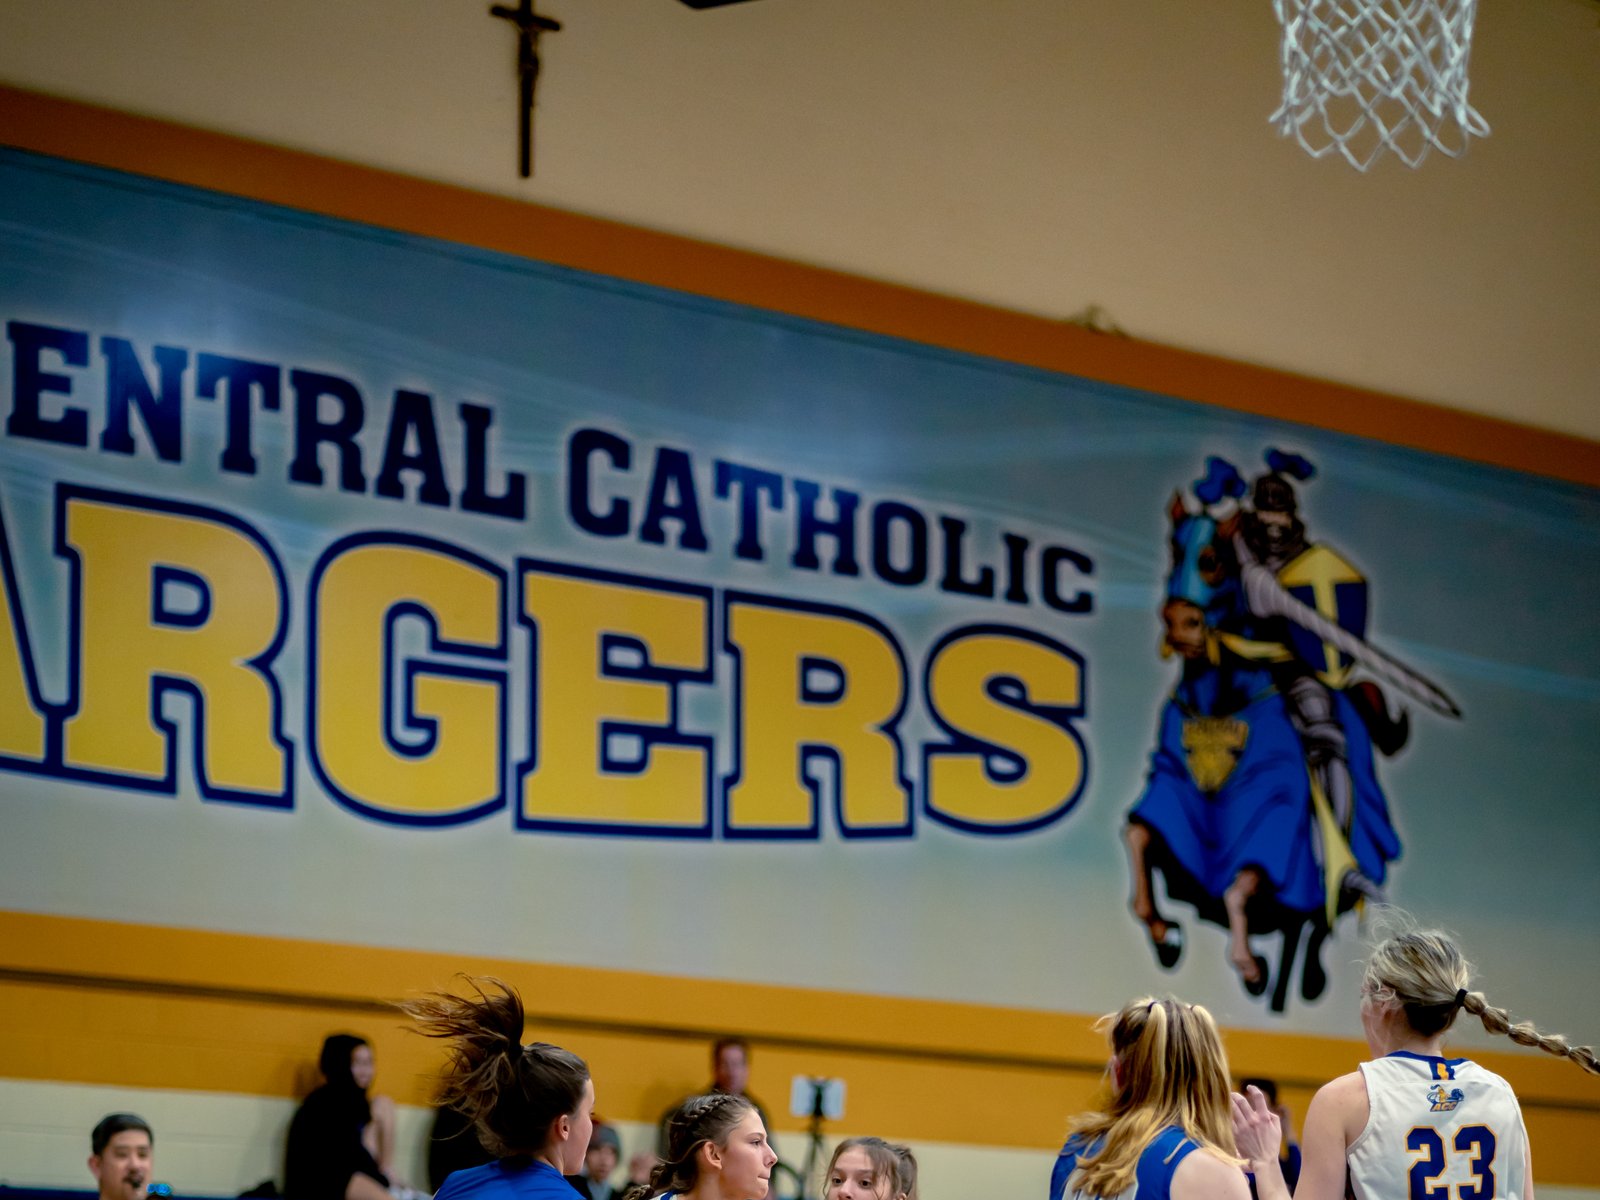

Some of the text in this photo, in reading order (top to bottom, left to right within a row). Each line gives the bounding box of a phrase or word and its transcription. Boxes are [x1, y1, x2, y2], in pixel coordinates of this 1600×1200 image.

[6, 319, 1095, 614] ENTRAL CATHOLIC
[0, 481, 1089, 843] RGERS
